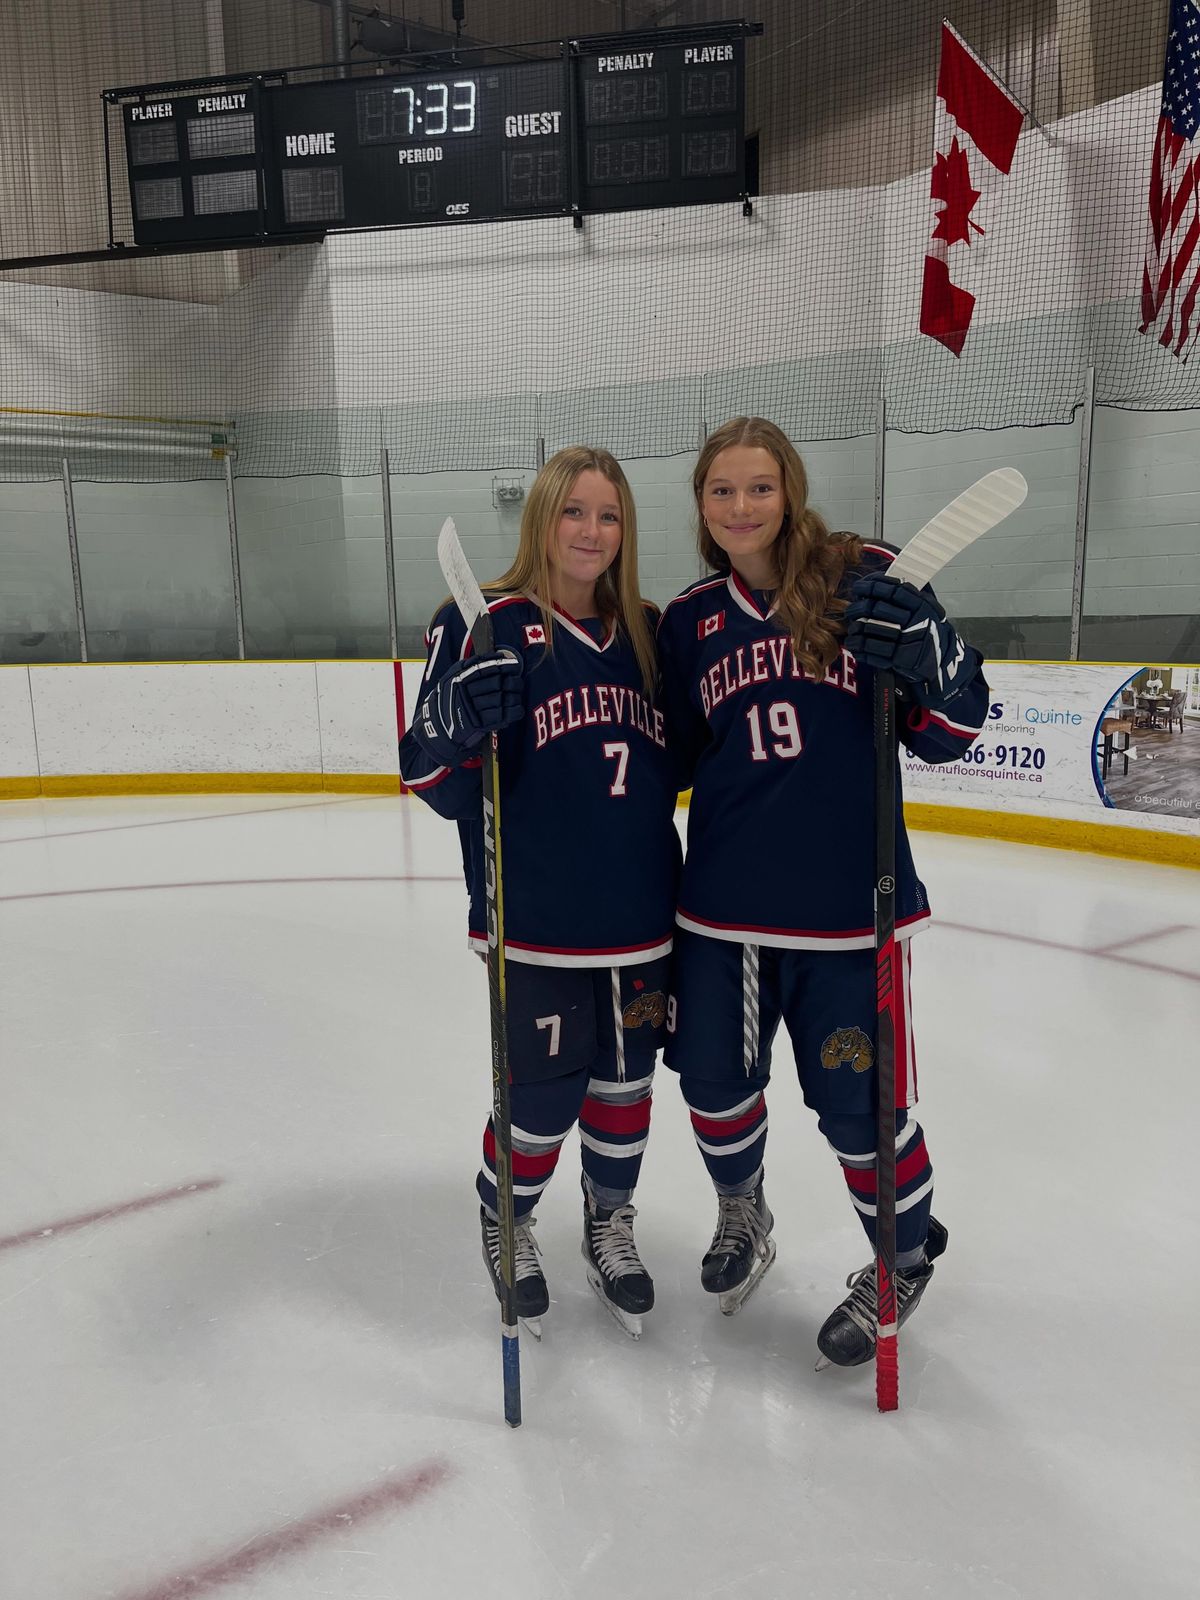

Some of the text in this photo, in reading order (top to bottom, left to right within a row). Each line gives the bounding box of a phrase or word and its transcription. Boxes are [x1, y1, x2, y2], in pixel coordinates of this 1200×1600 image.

[598, 52, 654, 73] PENALTY
[684, 45, 734, 64] PLAYER
[131, 102, 173, 121] PLAYER
[197, 93, 247, 113] PENALTY
[392, 80, 476, 136] 7:33
[505, 111, 562, 138] GUEST
[285, 132, 336, 157] HOME
[398, 146, 443, 165] PERIOD
[699, 636, 859, 720] BELLEVILE
[533, 684, 667, 750] BELLEVILLE
[1025, 707, 1082, 726] Quinte
[746, 700, 803, 761] 19
[995, 723, 1036, 736] Flooring
[603, 742, 630, 796] 7
[904, 762, 1043, 783] www.nufloorsquinte.ca
[483, 795, 499, 950] CCM
[535, 1013, 562, 1056] 7
